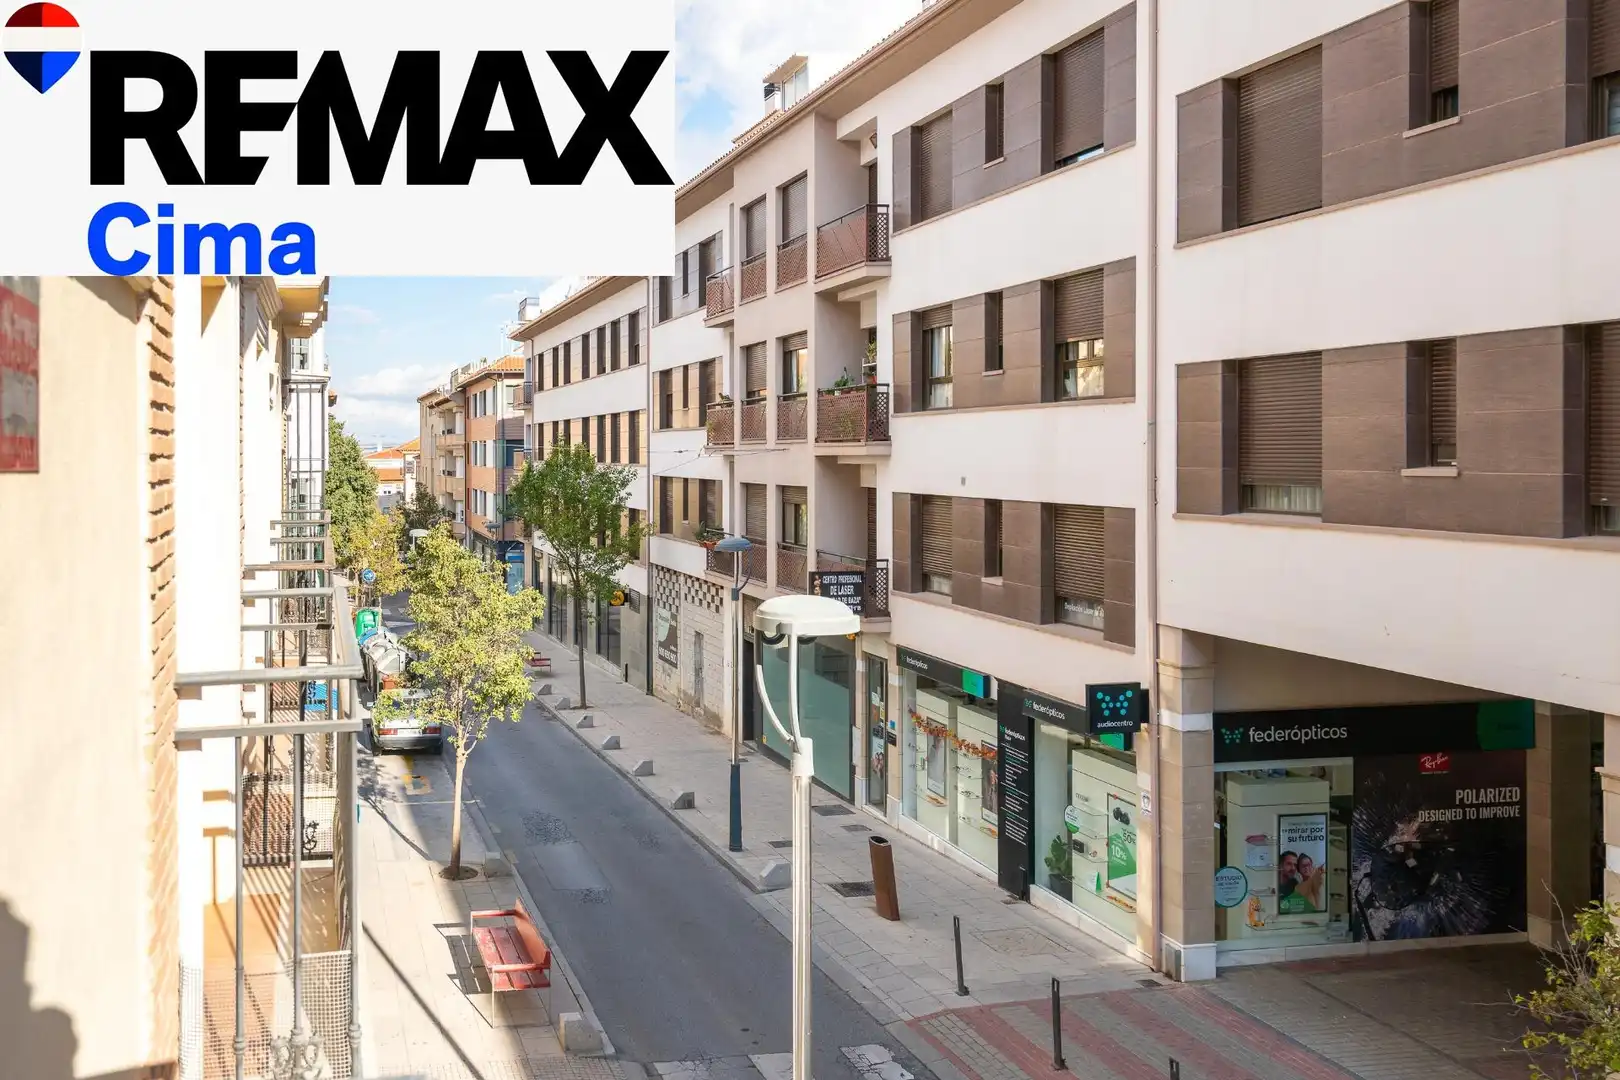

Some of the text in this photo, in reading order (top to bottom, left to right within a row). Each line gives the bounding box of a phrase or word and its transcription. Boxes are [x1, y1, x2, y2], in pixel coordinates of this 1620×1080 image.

[830, 585, 854, 595] DE LASER
[1032, 701, 1066, 720] federópticos
[1097, 720, 1134, 728] audiocentro
[1248, 723, 1348, 744] federópticos
[1455, 786, 1520, 805] POLARIZED
[1418, 805, 1520, 823] DESIGNED TO IMPROVE
[1287, 826, 1308, 834] mirar
[1298, 834, 1325, 842] futuro
